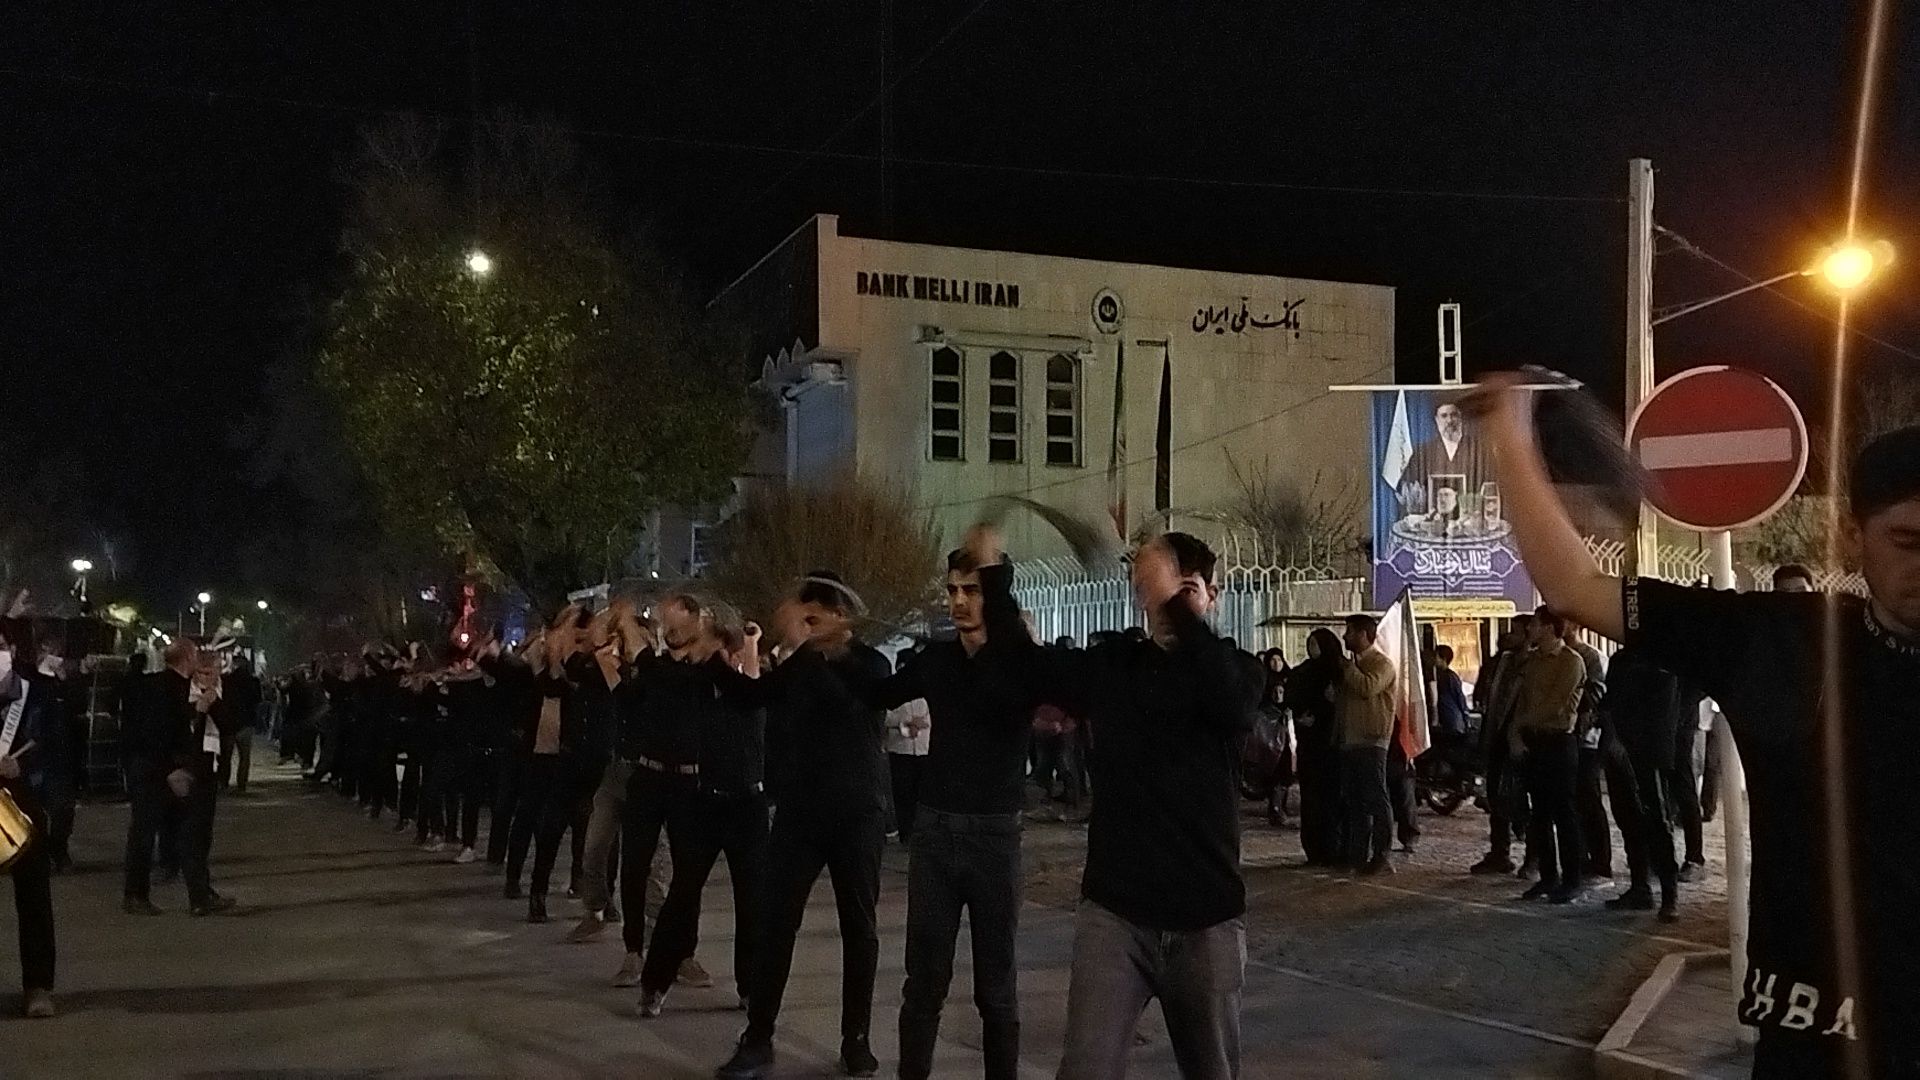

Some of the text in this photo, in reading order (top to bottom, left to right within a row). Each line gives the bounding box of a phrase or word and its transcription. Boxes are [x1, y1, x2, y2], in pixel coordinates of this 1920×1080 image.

[857, 271, 1019, 308] BANK MELLI IRAN
[1192, 296, 1305, 339] بانک ملی ایران
[1625, 588, 1640, 631] TREND
